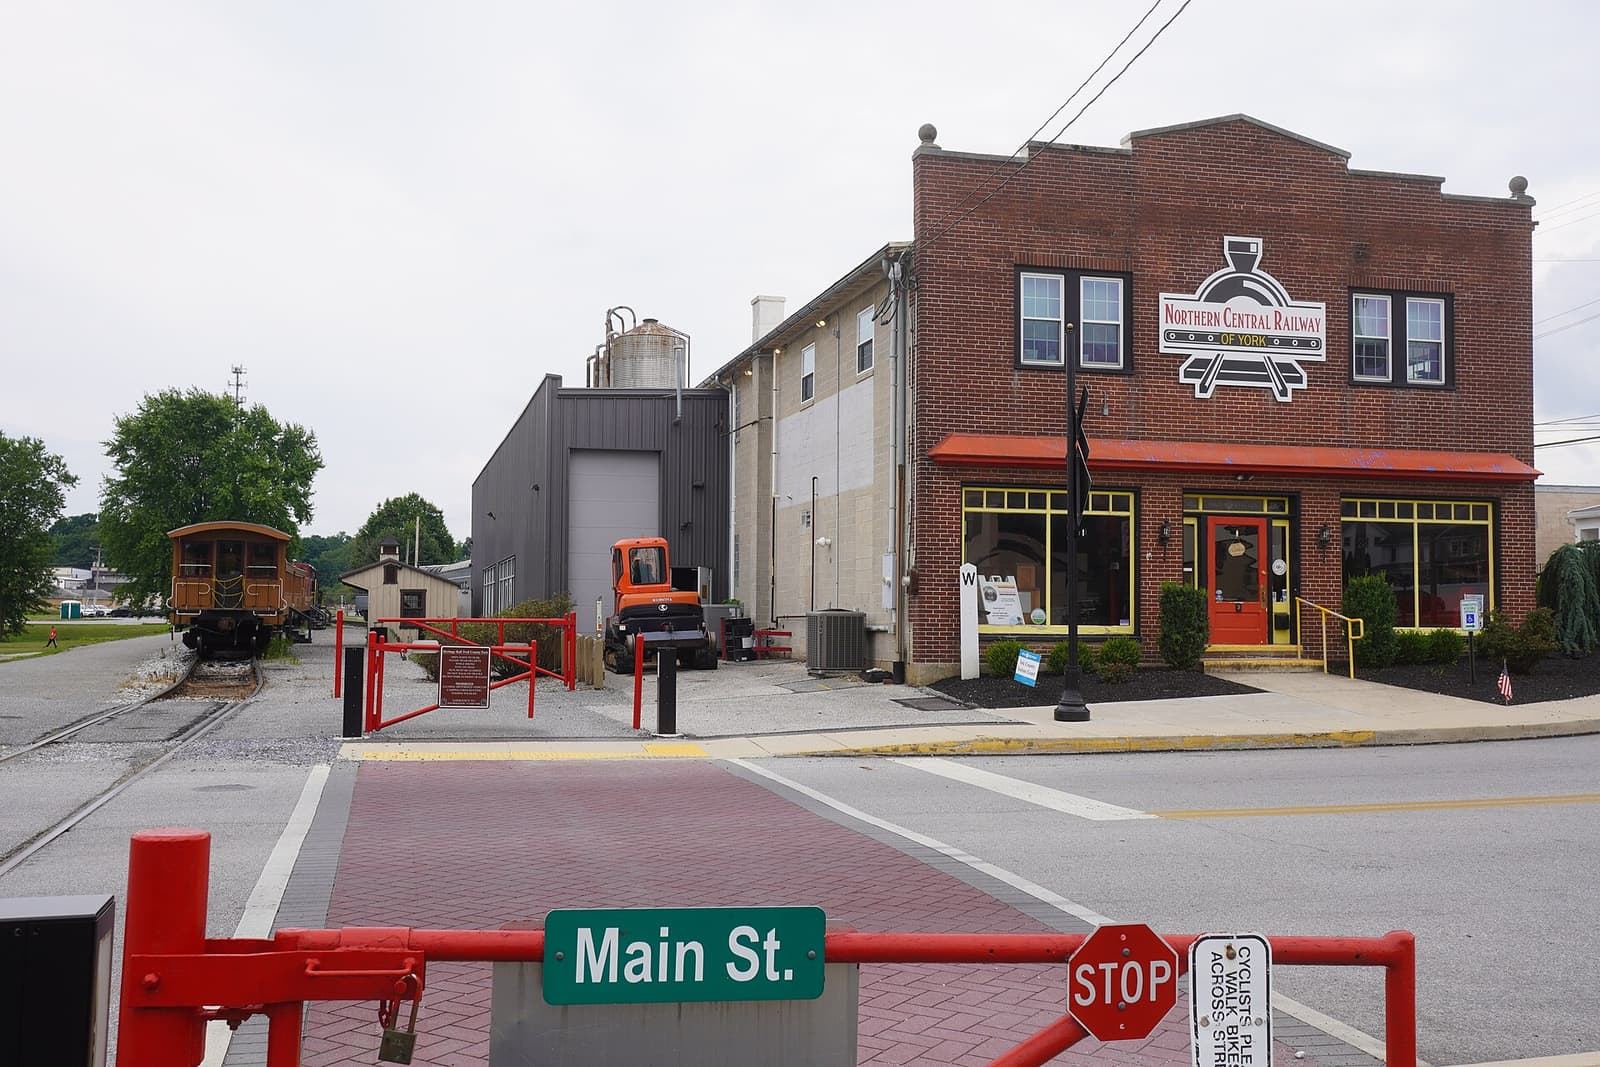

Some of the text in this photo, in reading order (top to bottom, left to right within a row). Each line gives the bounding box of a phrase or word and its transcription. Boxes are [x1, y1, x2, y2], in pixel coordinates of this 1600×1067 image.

[1165, 303, 1321, 333] NORTHERN CENTRAL RAILWAY
[1221, 334, 1266, 346] OF YORK
[962, 572, 975, 586] W
[575, 924, 794, 984] Main St.
[1074, 960, 1172, 1007] STOP
[1211, 952, 1225, 1022] ACROSS
[1225, 971, 1238, 1017] WALK
[1238, 946, 1253, 1067] CYCLISTS PLE
